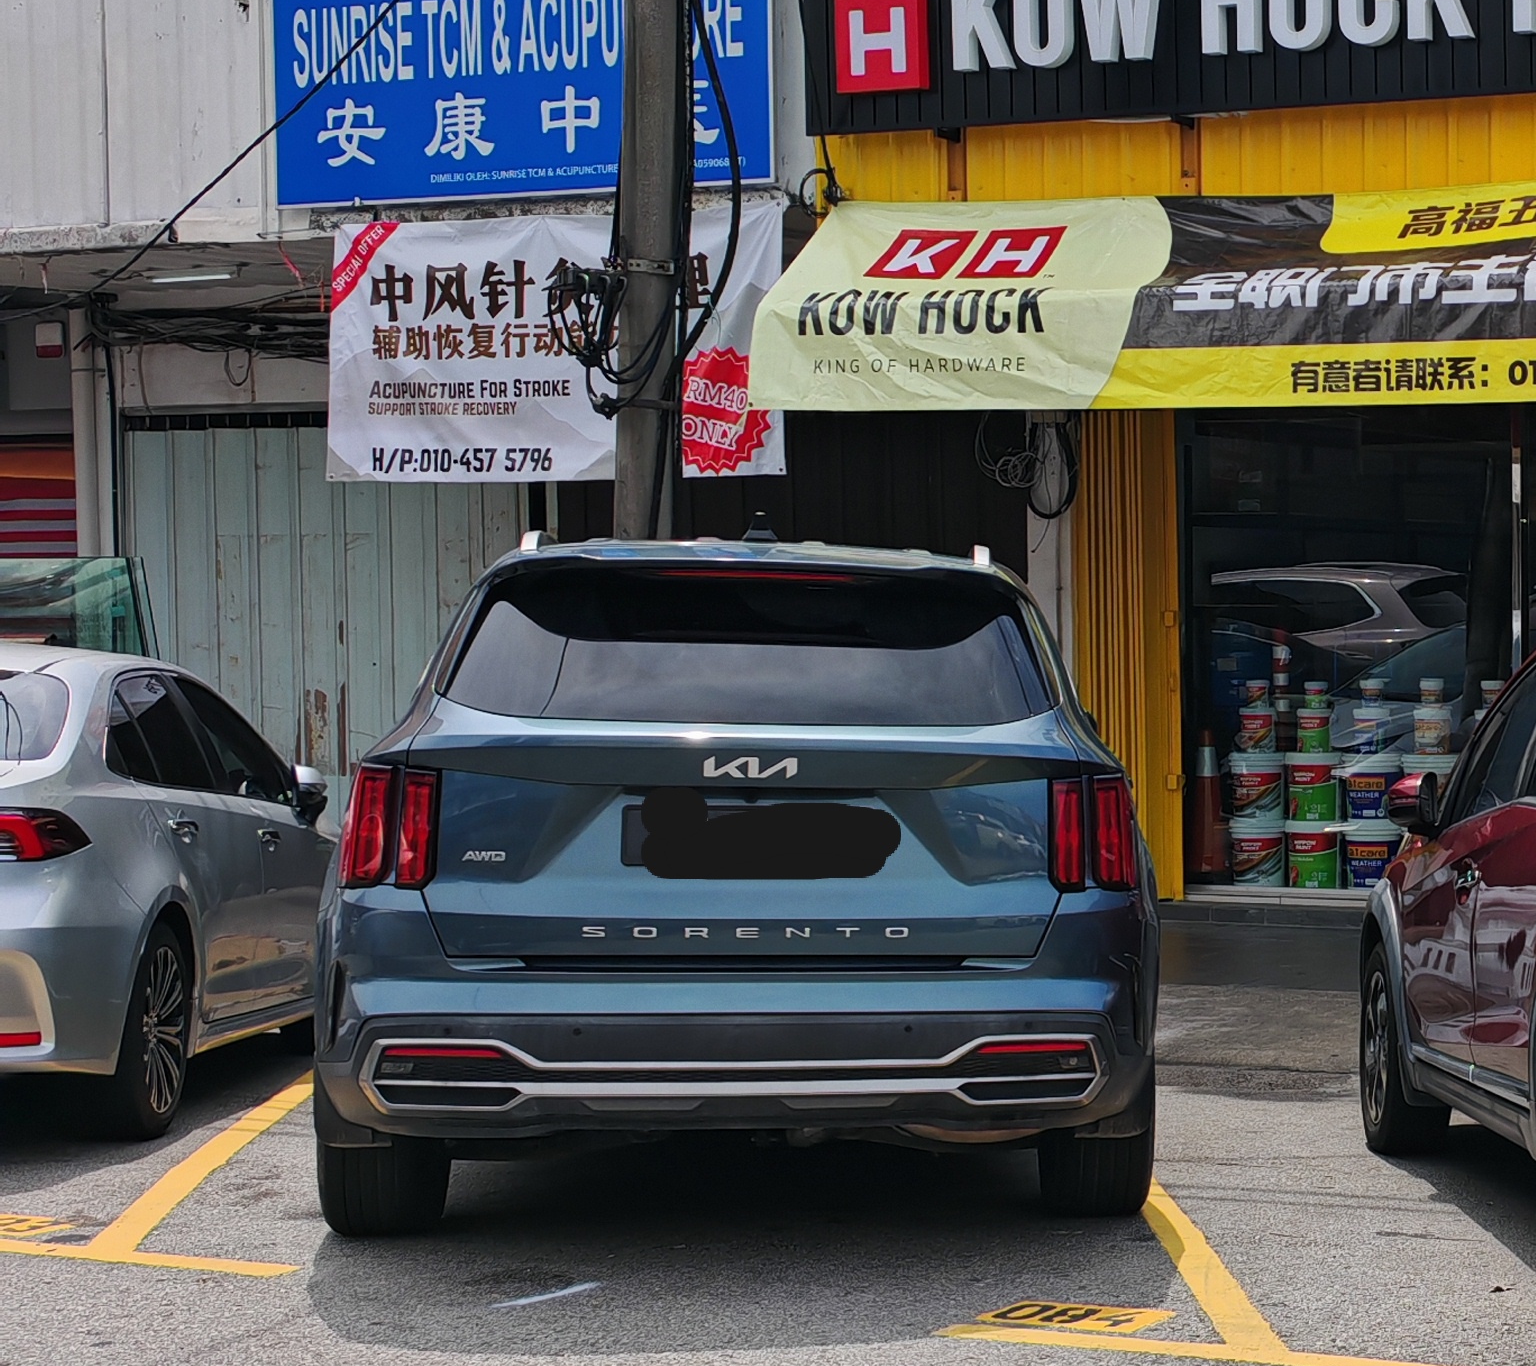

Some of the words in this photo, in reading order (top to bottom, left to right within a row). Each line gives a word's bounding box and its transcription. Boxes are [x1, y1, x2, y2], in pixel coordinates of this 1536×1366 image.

[293, 1, 414, 88] SUNRISE
[848, 6, 907, 76] H
[528, 167, 546, 178] TCM
[547, 167, 554, 177] &
[332, 255, 364, 292] SPECIAL
[357, 224, 386, 256] OFFER
[797, 289, 910, 336] KOW
[917, 287, 1055, 335] HOCK
[813, 358, 860, 374] KING
[871, 358, 898, 373] OF
[908, 357, 1026, 373] HARDWARE
[686, 378, 749, 412] RM40
[368, 402, 417, 416] SUPPORT
[419, 402, 459, 415] STROKE
[462, 401, 518, 415] RECOVERY
[682, 417, 740, 450] ONLY
[505, 448, 553, 472] 5796
[703, 756, 798, 778] KIA
[462, 851, 506, 862] AWD
[582, 926, 910, 938] SORENTO
